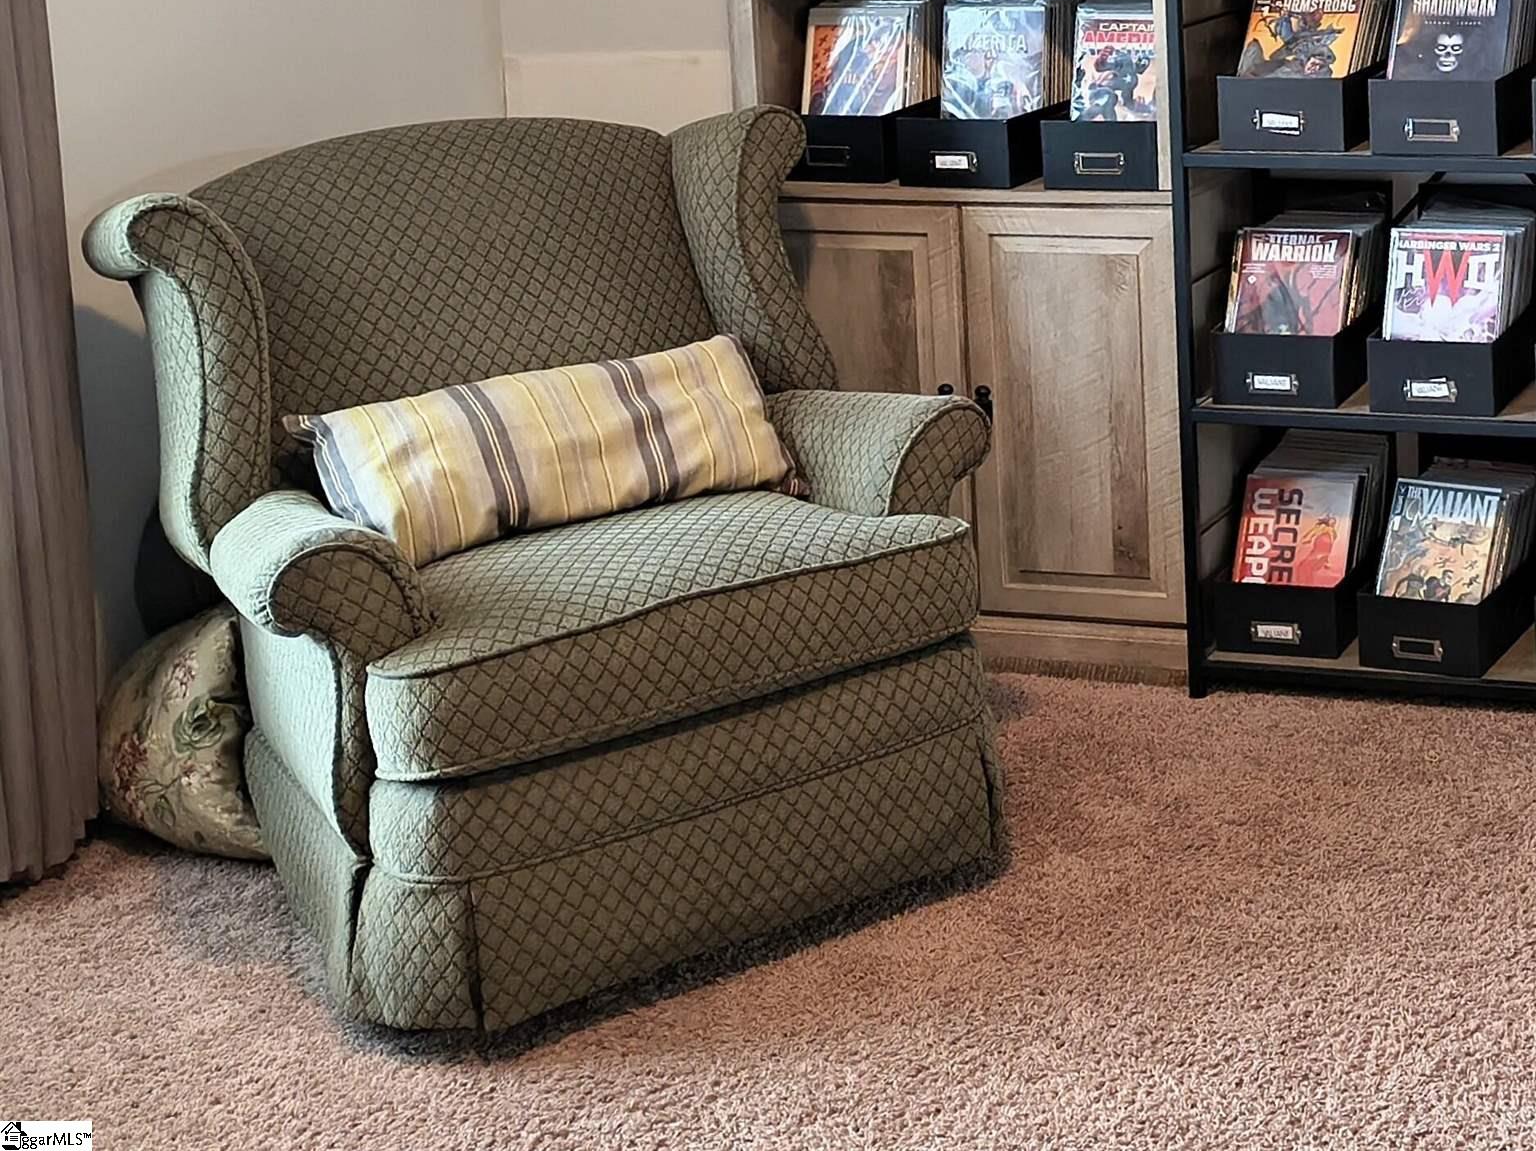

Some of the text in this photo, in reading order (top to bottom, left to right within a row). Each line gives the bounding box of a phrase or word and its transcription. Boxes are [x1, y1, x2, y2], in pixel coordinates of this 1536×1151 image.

[1251, 236, 1338, 263] WARRIOR
[1459, 242, 1490, 250] WARS
[1420, 487, 1501, 529] VALIANT
